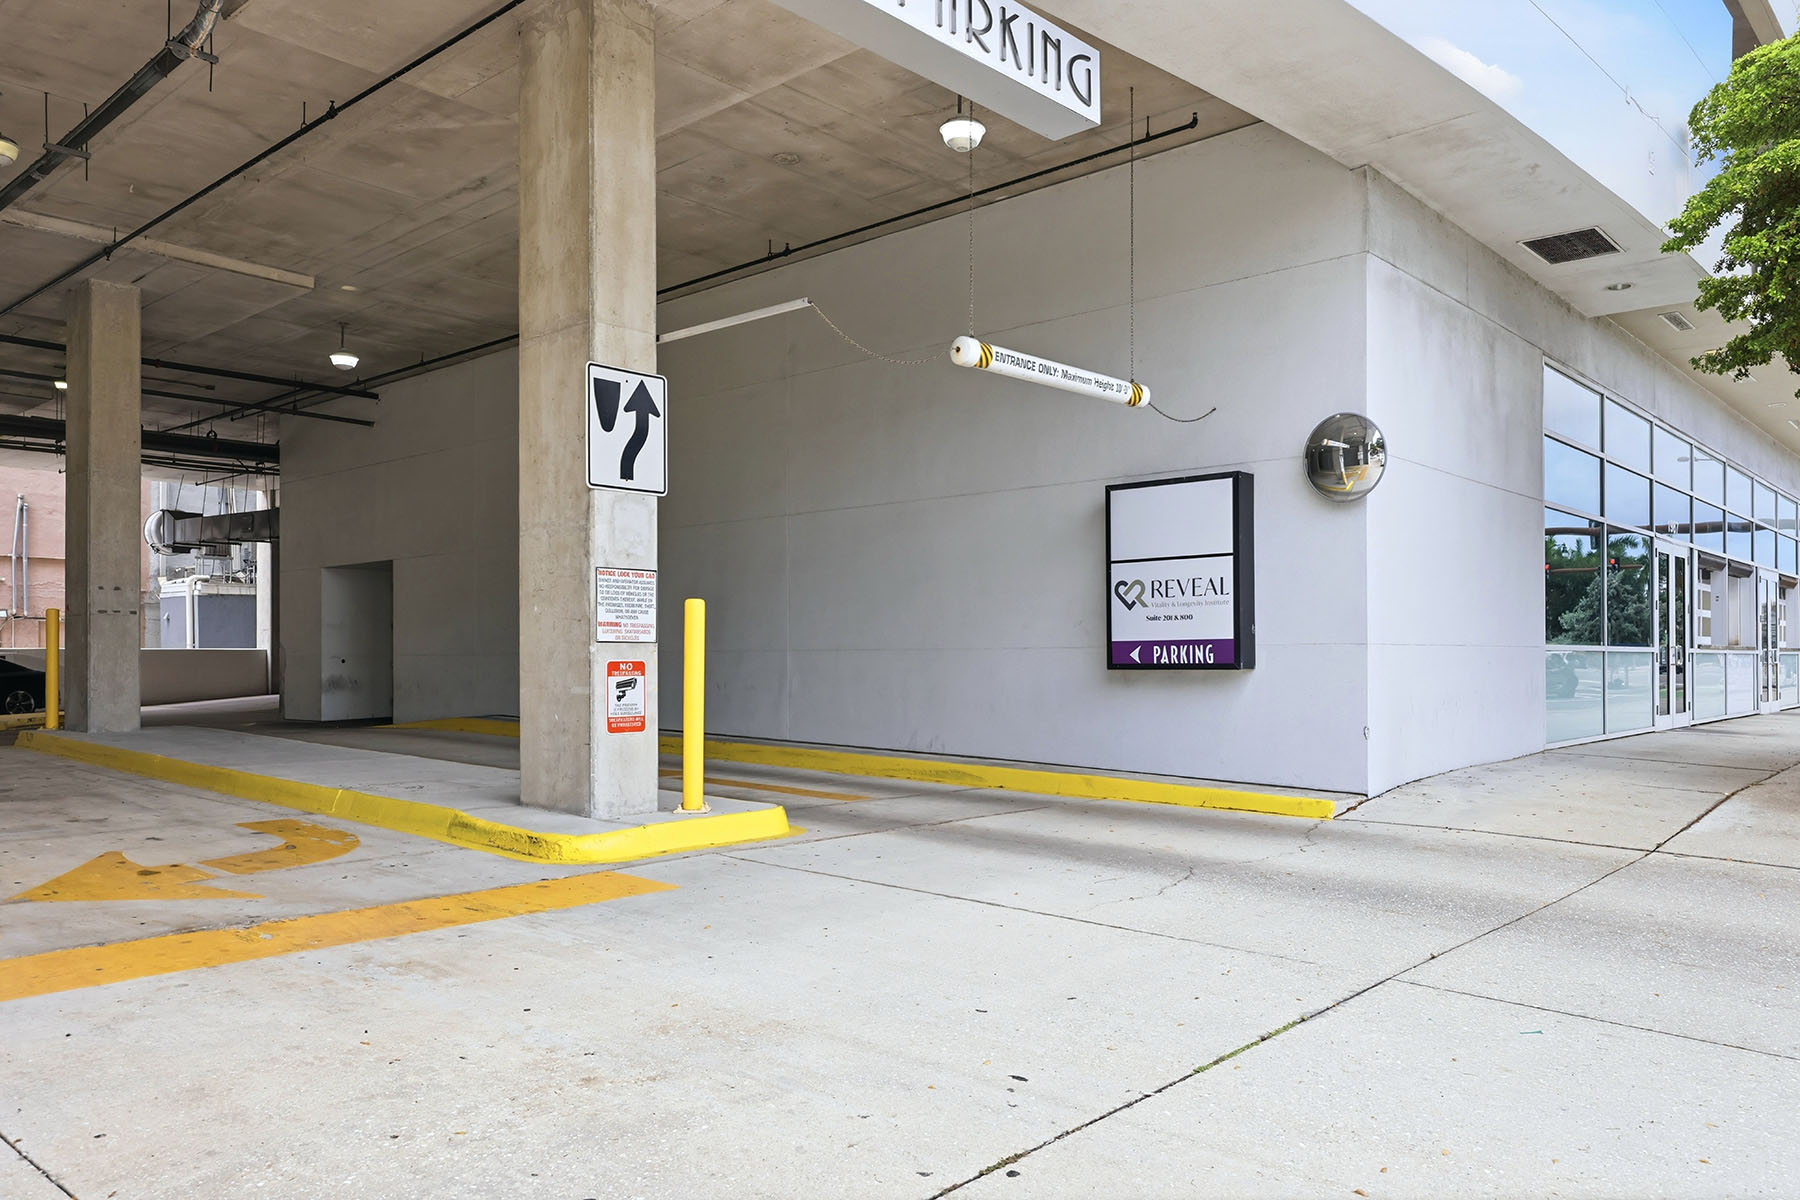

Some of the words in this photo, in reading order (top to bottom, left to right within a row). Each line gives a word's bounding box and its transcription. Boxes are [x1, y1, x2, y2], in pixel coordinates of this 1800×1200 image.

[897, 0, 1092, 107] RKING
[994, 351, 1036, 372] ENTRANCE
[1038, 362, 1060, 378] ONLY:
[1060, 369, 1093, 386] Maximum
[1151, 577, 1230, 599] REVEAL
[1163, 614, 1173, 622] 201
[1153, 644, 1214, 664] PARKING
[619, 663, 633, 671] NO
